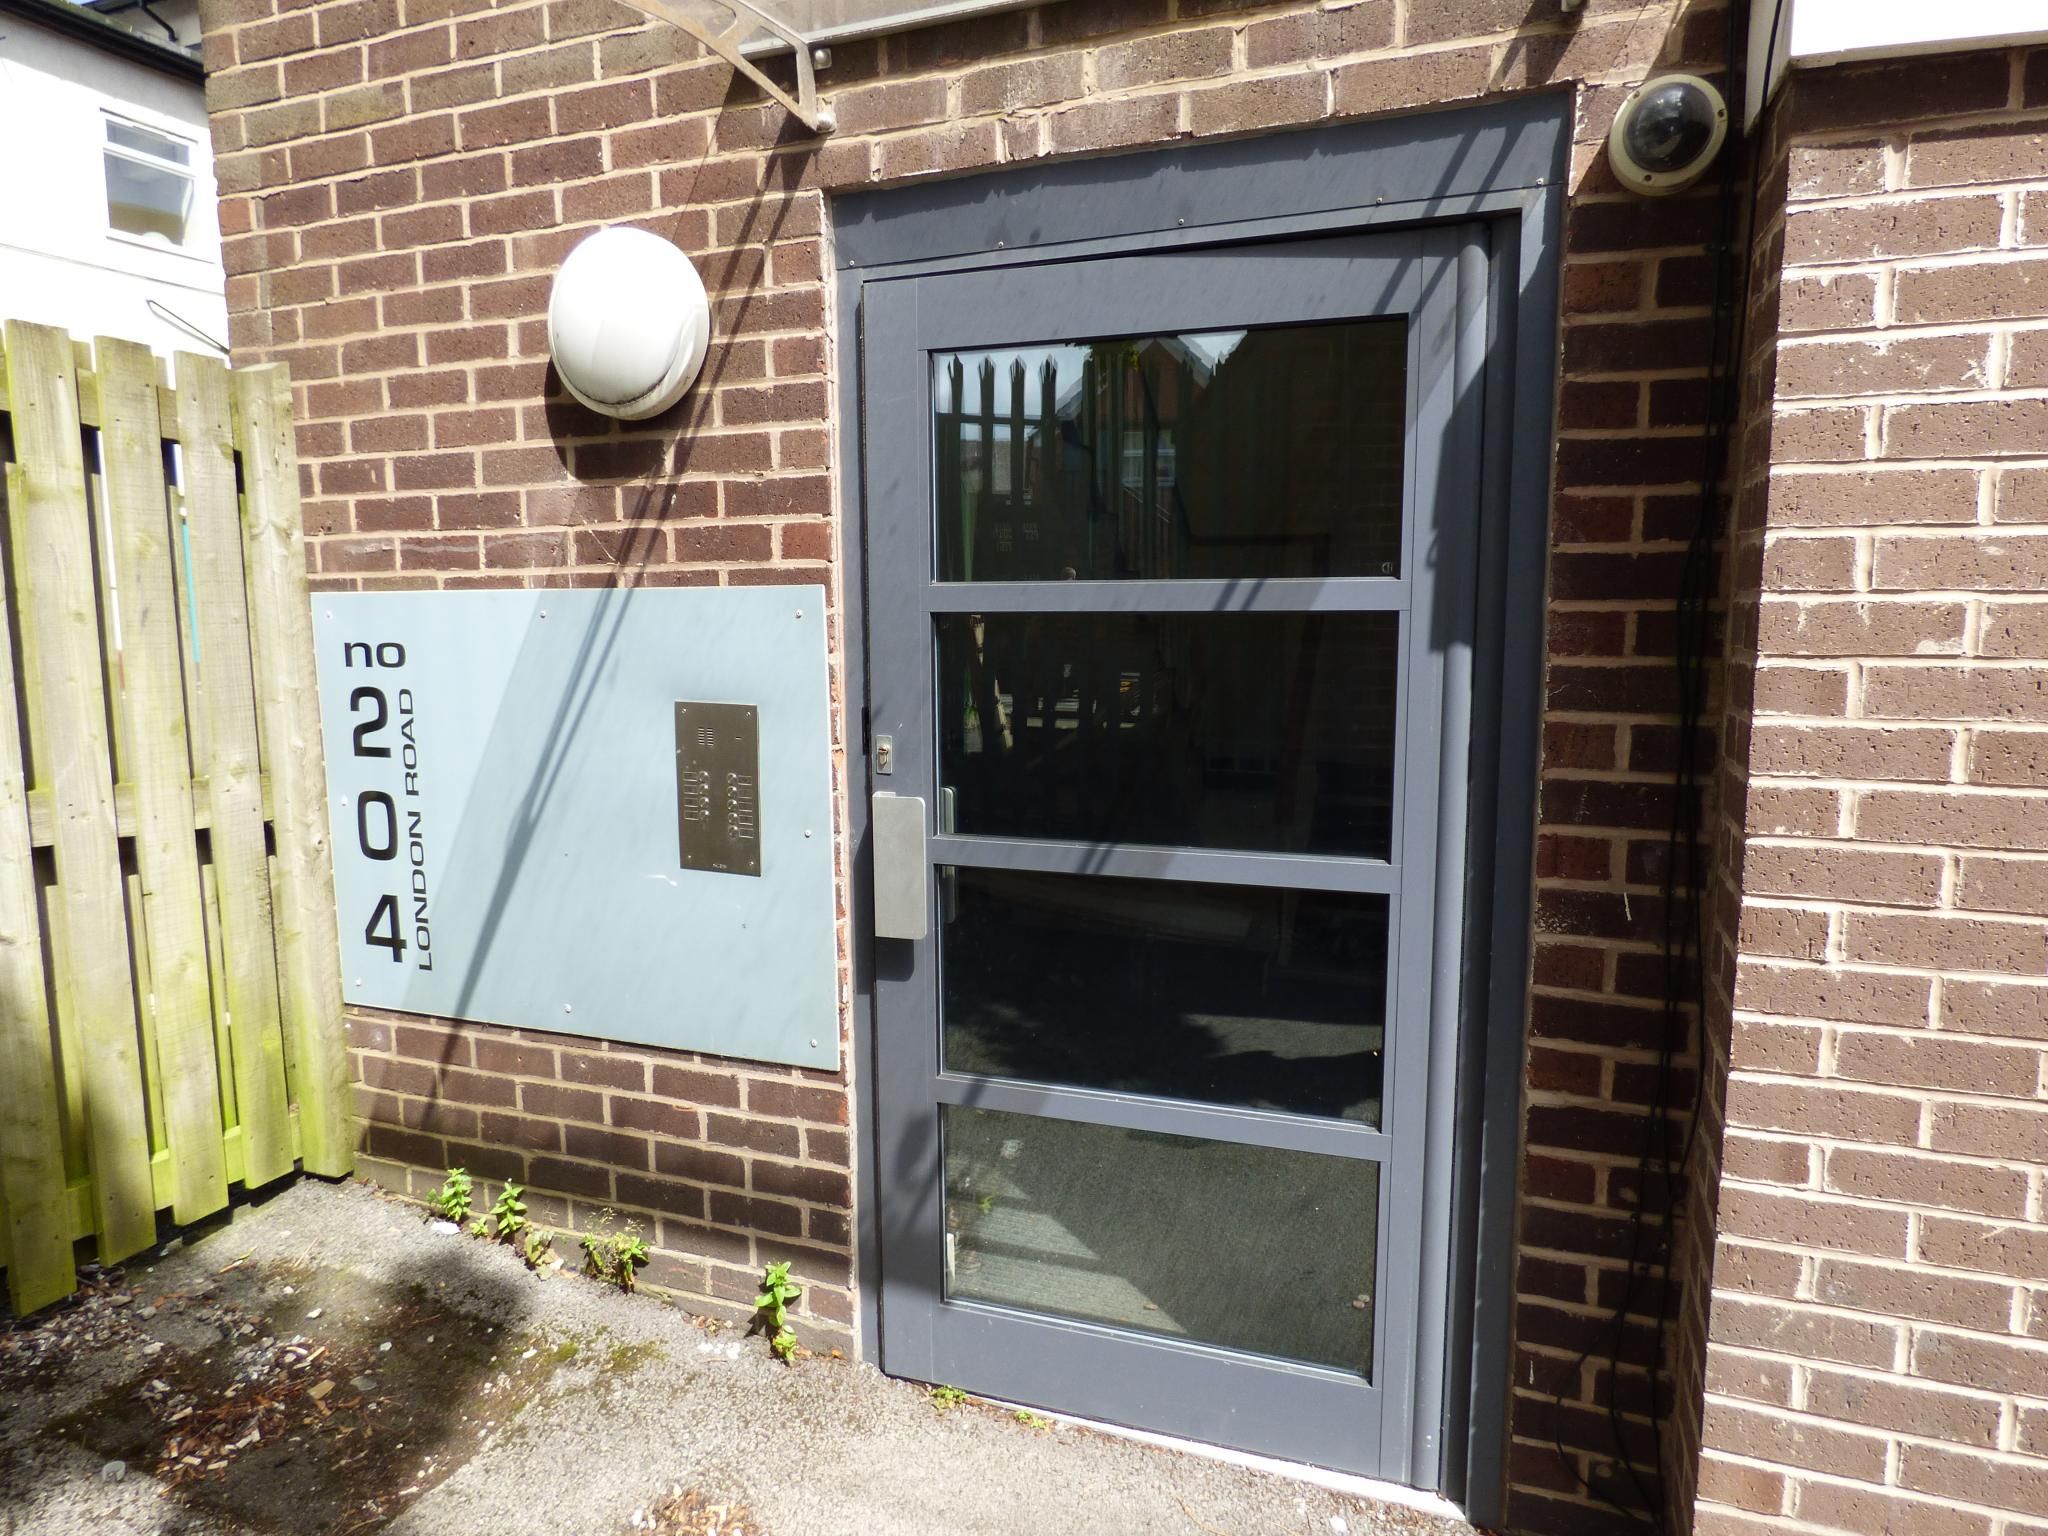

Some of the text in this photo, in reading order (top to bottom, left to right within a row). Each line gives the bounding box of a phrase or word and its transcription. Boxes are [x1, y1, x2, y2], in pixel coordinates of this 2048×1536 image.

[344, 642, 406, 668] no
[350, 686, 407, 963] 204
[398, 687, 433, 971] LONDON ROAD
